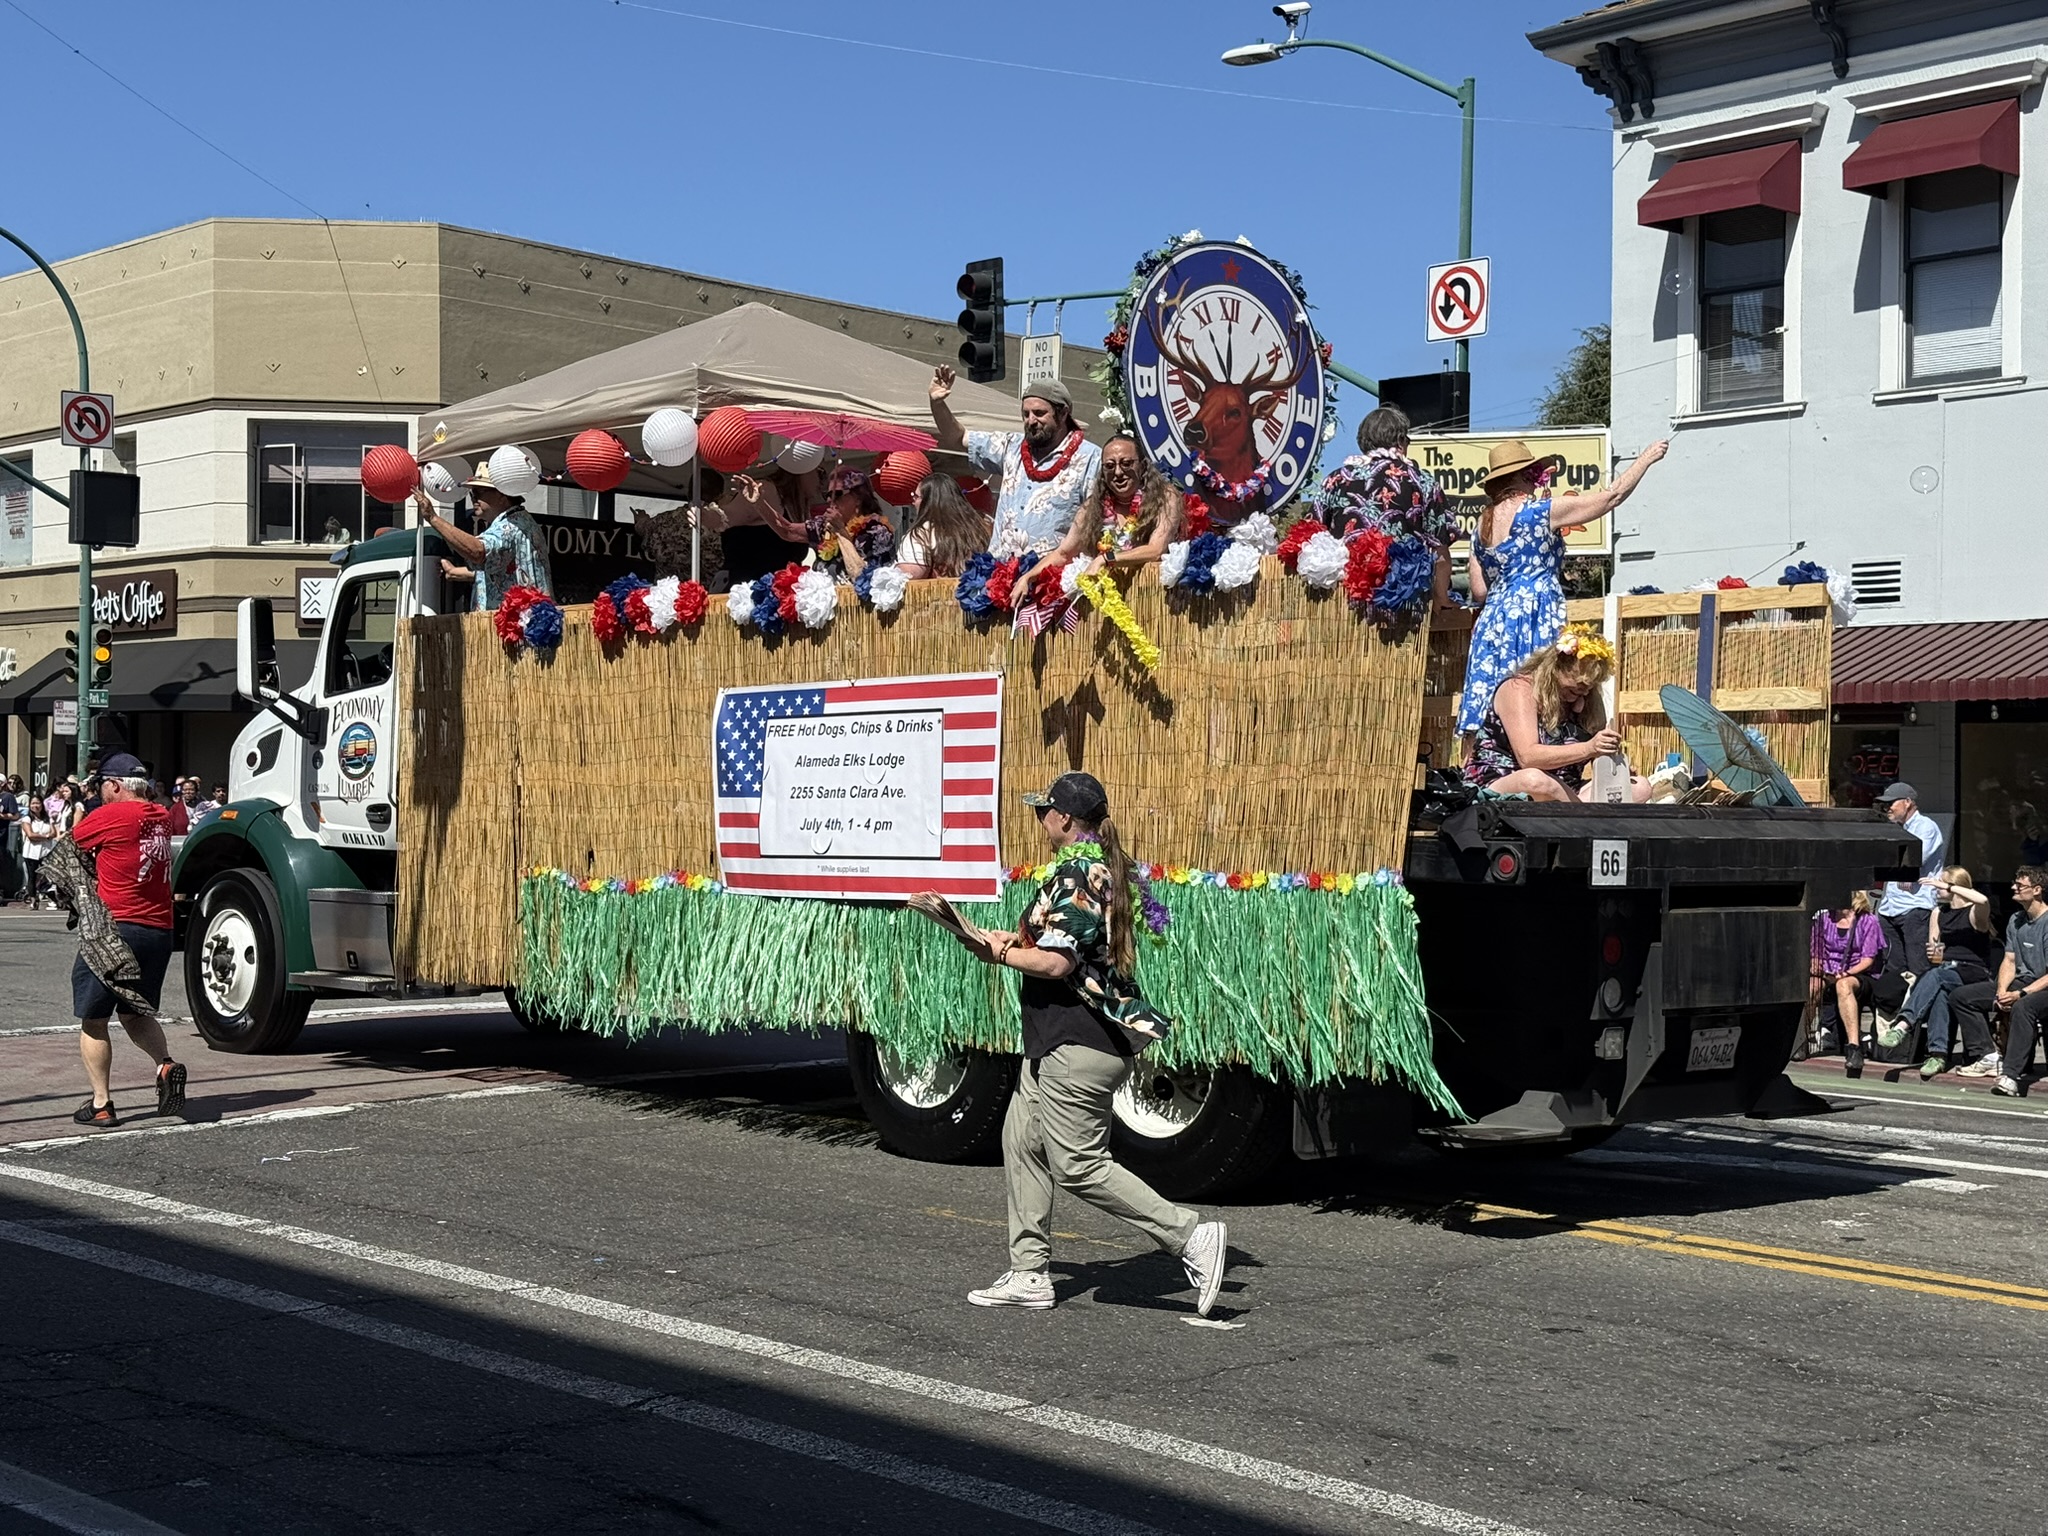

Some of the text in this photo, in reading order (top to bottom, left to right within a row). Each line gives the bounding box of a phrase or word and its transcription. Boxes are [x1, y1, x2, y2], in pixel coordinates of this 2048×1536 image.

[1035, 341, 1048, 353] NO
[1028, 355, 1054, 369] LEFT
[1424, 446, 1453, 467] The
[1549, 454, 1600, 491] Pup
[122, 580, 164, 625] Coffee
[331, 695, 385, 735] ECONOMY
[767, 719, 933, 738] FREE Hot Dogs, Chips & Drinks
[794, 752, 905, 769] Alameda Elks Lodge
[337, 771, 375, 806] LUMBER
[790, 785, 907, 799] 2255 Santa Clara Ave.
[800, 818, 823, 834] July
[824, 818, 844, 833] 4th,
[848, 818, 854, 830] 1
[864, 818, 871, 830] 4
[874, 820, 893, 833] pm
[342, 832, 386, 847] OAKLAND
[820, 865, 871, 874] While supplies last
[1601, 850, 1620, 876] 66
